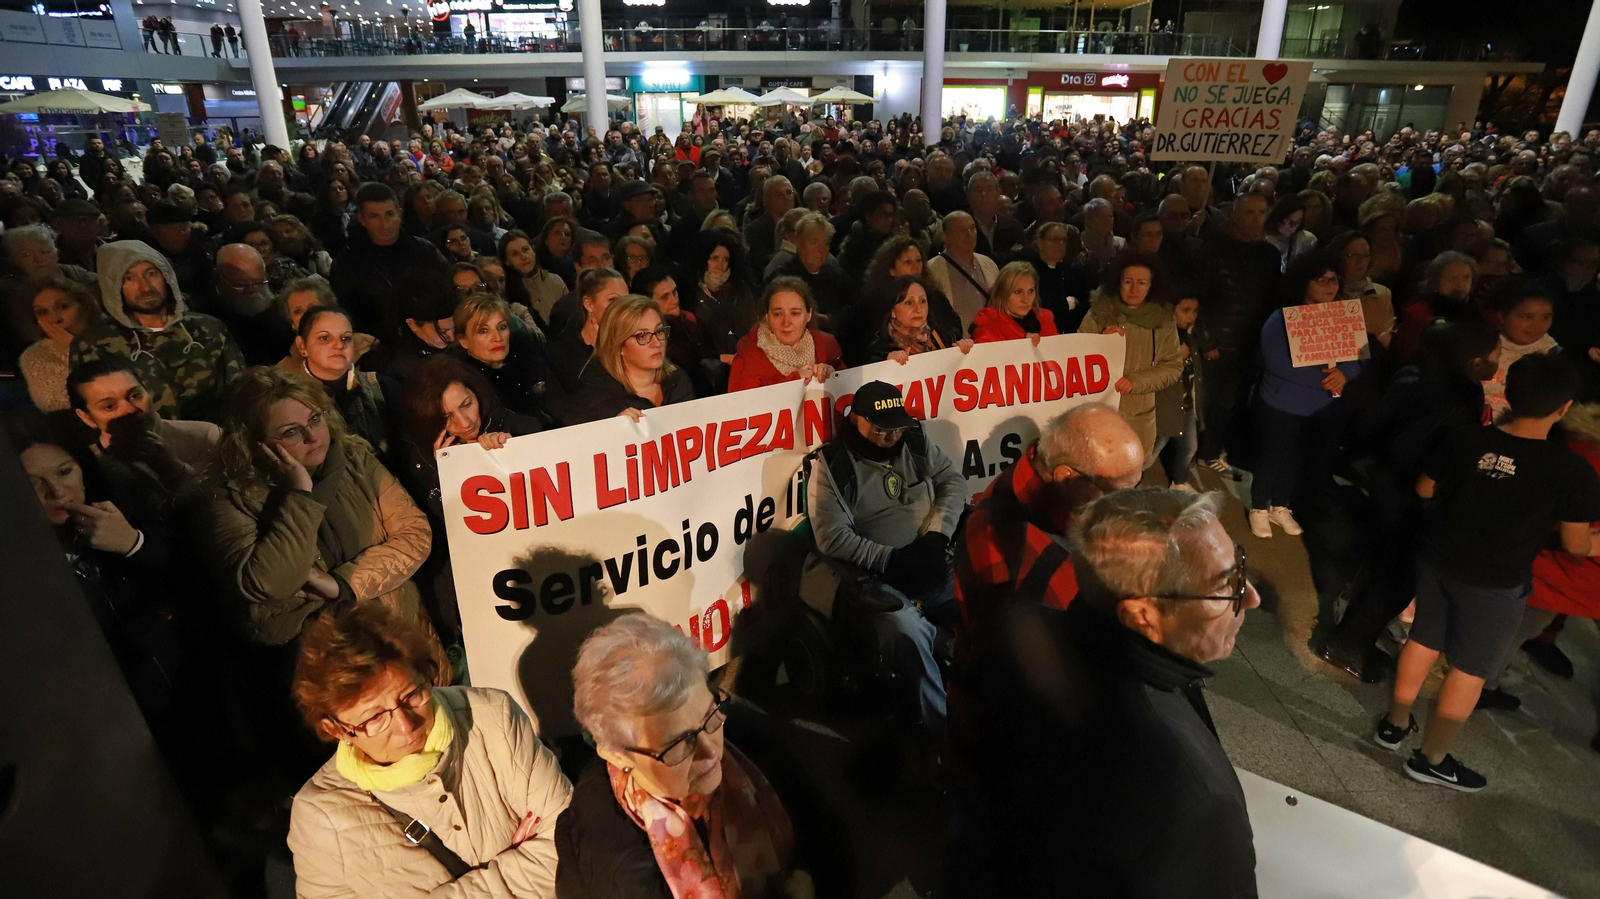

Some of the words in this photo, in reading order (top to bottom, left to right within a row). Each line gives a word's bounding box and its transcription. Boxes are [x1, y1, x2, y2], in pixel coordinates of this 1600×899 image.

[1184, 62, 1221, 83] CON
[1226, 63, 1250, 83] EL
[1173, 85, 1199, 103] NO
[1204, 85, 1230, 104] SE
[1299, 305, 1319, 313] POR
[1323, 301, 1345, 309] UNA
[1302, 309, 1346, 320] SANIDAD
[1333, 316, 1364, 325] DIGNA
[1291, 328, 1319, 338] PARA
[1321, 325, 1349, 335] TODO
[1352, 323, 1365, 331] EL
[1300, 334, 1338, 345] CAMPO
[1342, 332, 1355, 340] DE
[1299, 341, 1356, 353] GIBRALTAR
[460, 461, 575, 535] SIN
[894, 373, 946, 421] AY
[953, 354, 1110, 412] SANIDAD
[492, 518, 719, 621] Servicio
[733, 494, 776, 545] de
